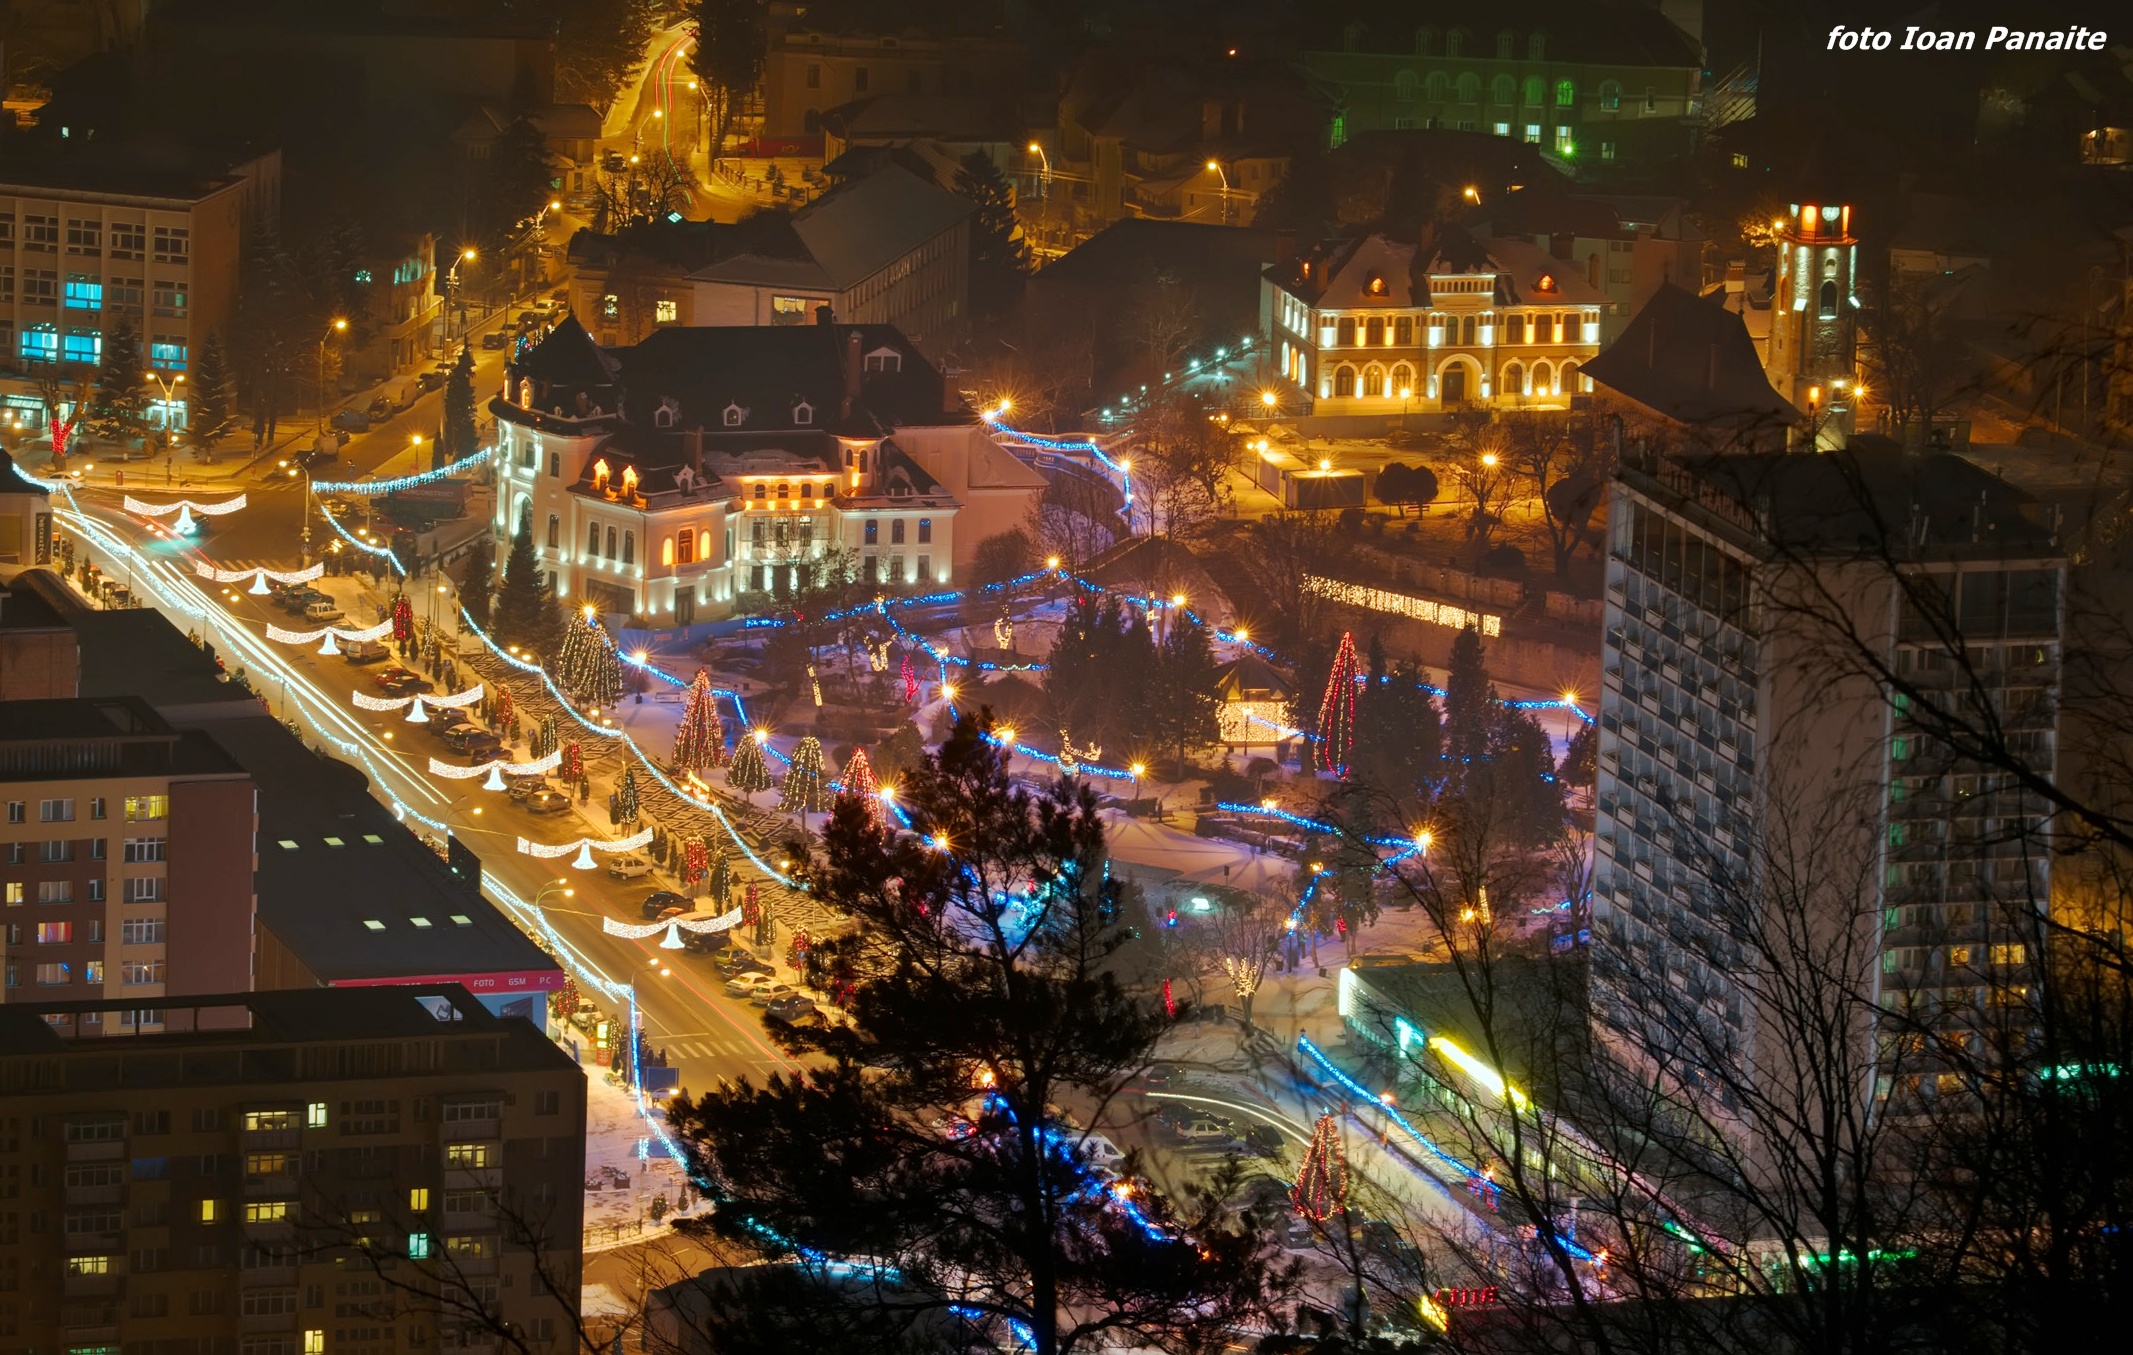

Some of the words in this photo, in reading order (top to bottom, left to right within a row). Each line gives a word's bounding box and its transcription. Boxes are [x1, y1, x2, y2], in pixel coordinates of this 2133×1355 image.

[1657, 456, 1694, 498] HOTEL
[473, 979, 495, 987] FOTO
[508, 978, 526, 986] GSM
[539, 977, 551, 985] PC
